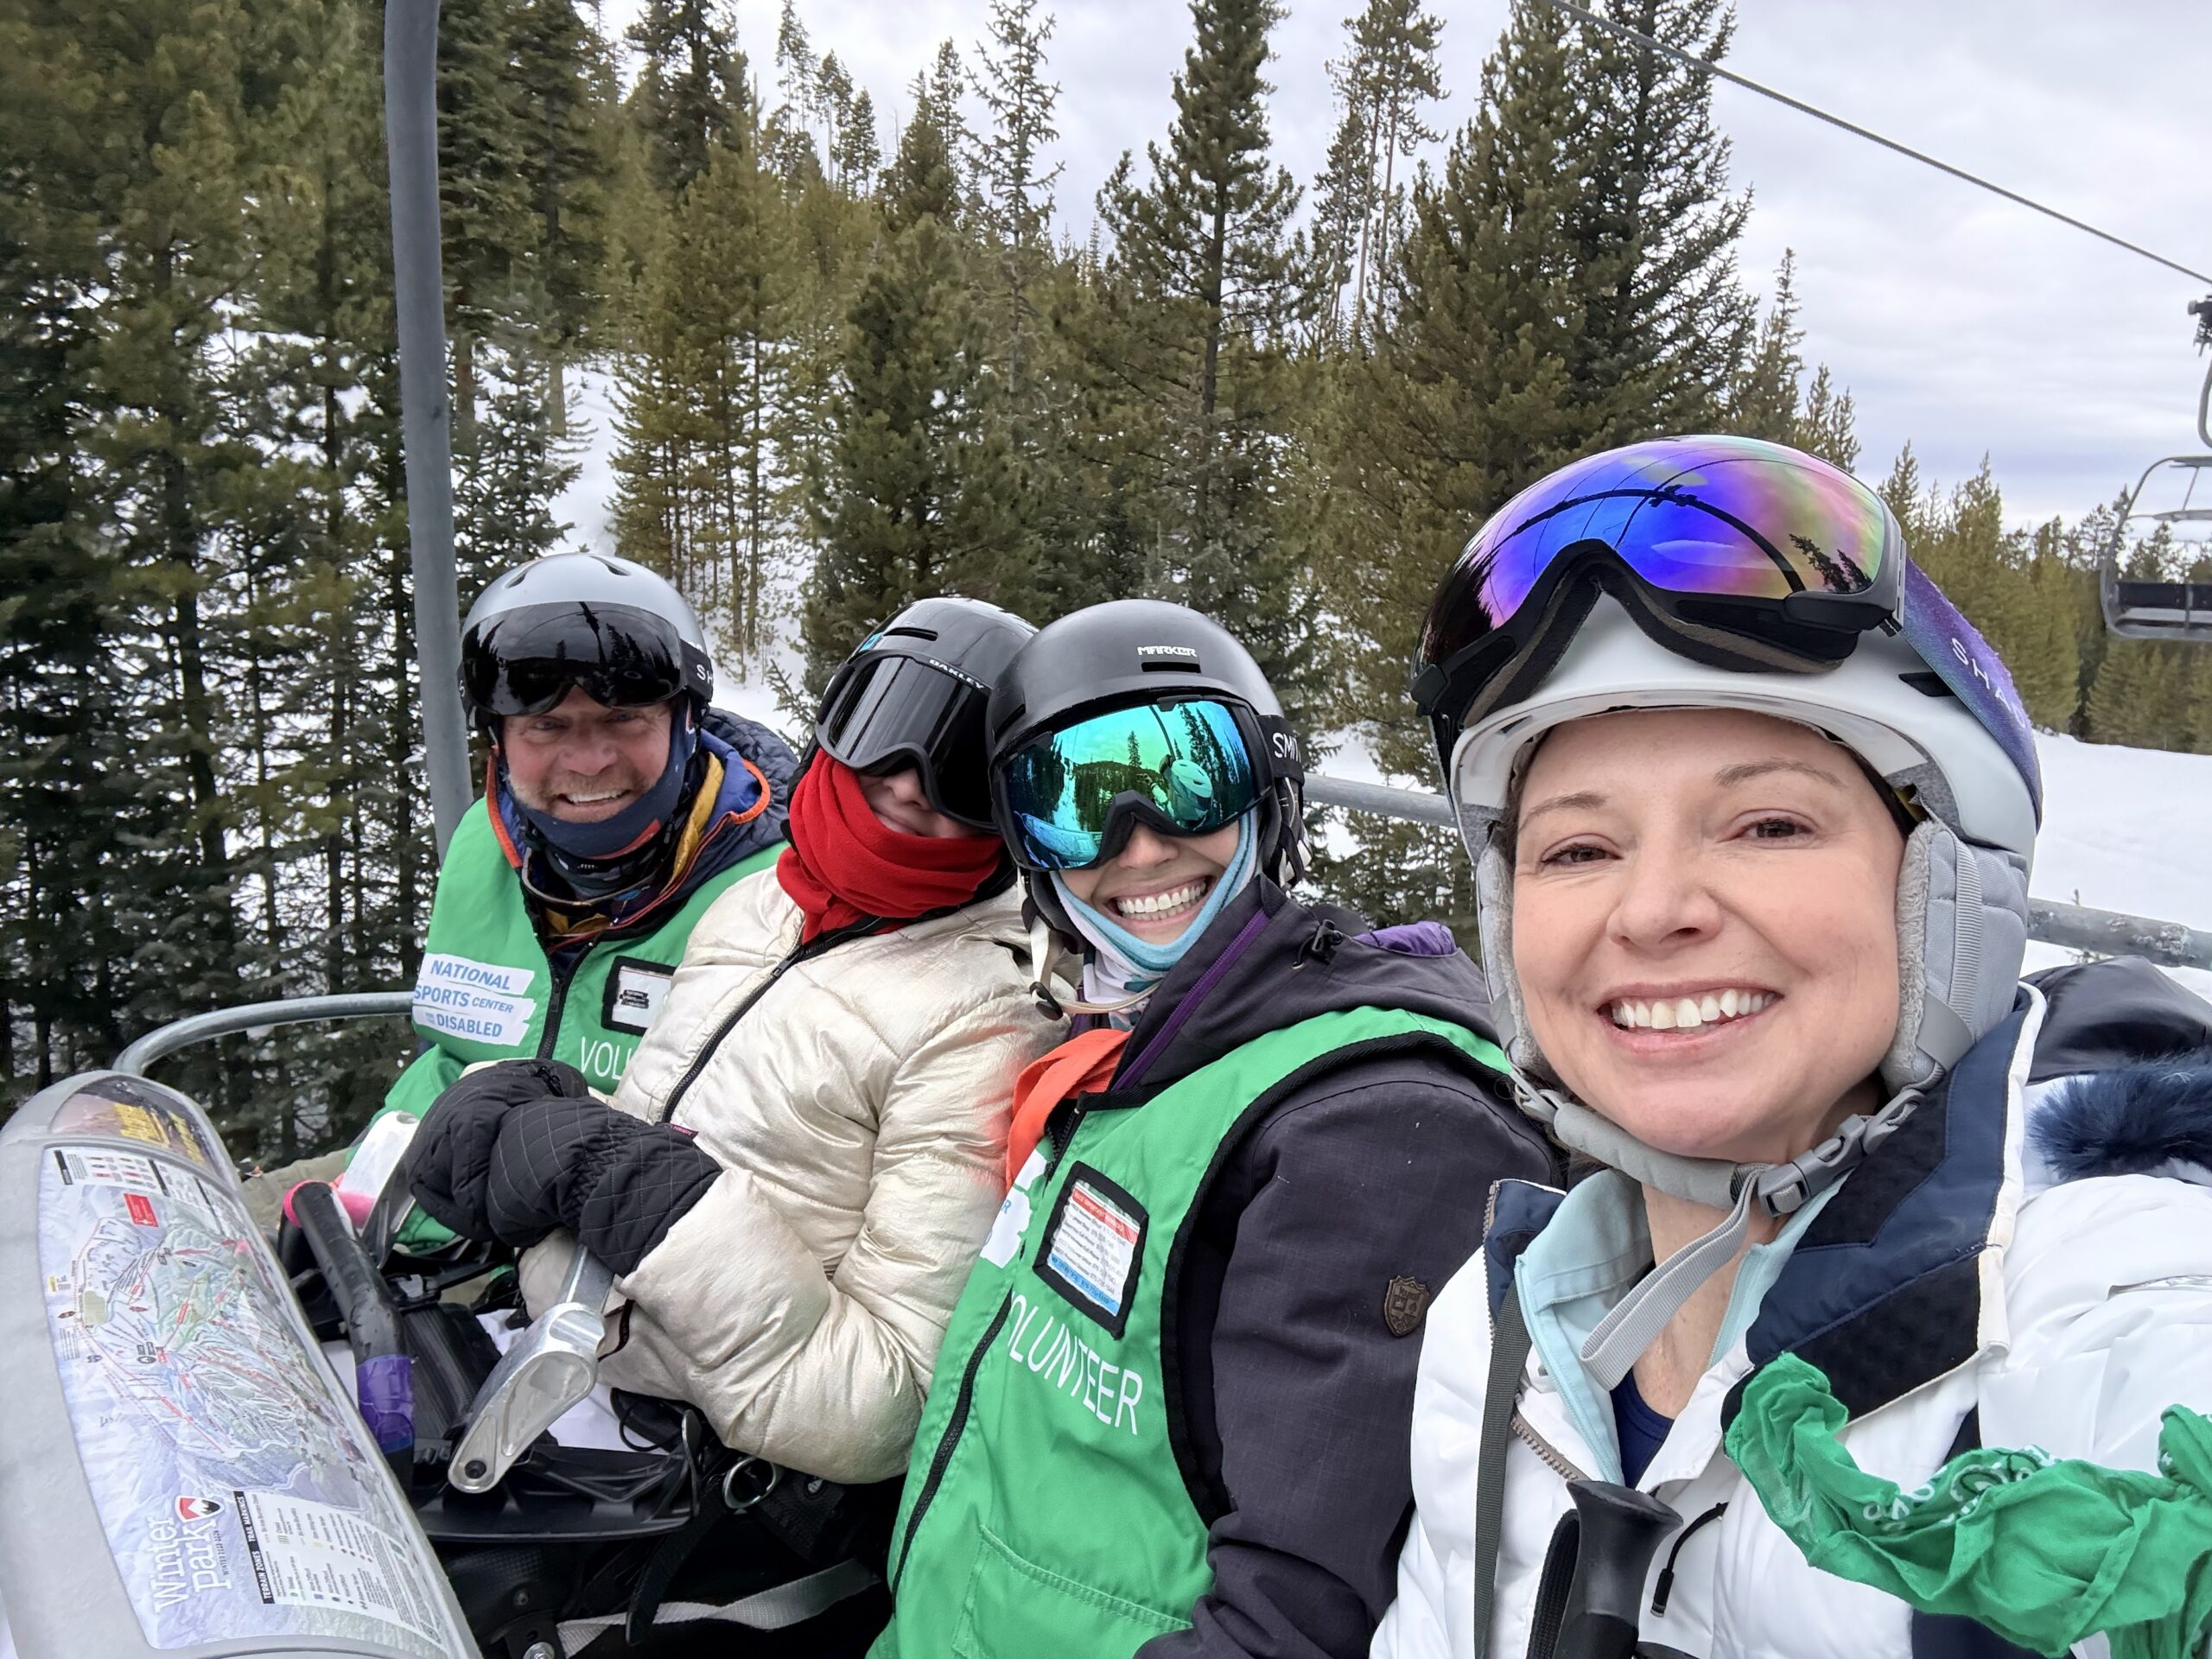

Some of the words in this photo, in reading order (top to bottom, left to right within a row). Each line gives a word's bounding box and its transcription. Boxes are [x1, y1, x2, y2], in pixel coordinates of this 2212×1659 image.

[1137, 645, 1198, 657] MARKER
[930, 659, 984, 689] OAKLEY
[430, 960, 510, 990] NATIONAL
[415, 984, 470, 1007] SPORTS
[472, 996, 514, 1014] CENTER
[436, 1014, 502, 1038] DISABLED
[581, 1036, 632, 1080] VOL
[237, 1497, 252, 1526] MARKINGS
[245, 1527, 256, 1542] TRAIL
[145, 1514, 189, 1613] Winter
[251, 1551, 264, 1571] ZONES
[257, 1571, 273, 1599] TERRAIN
